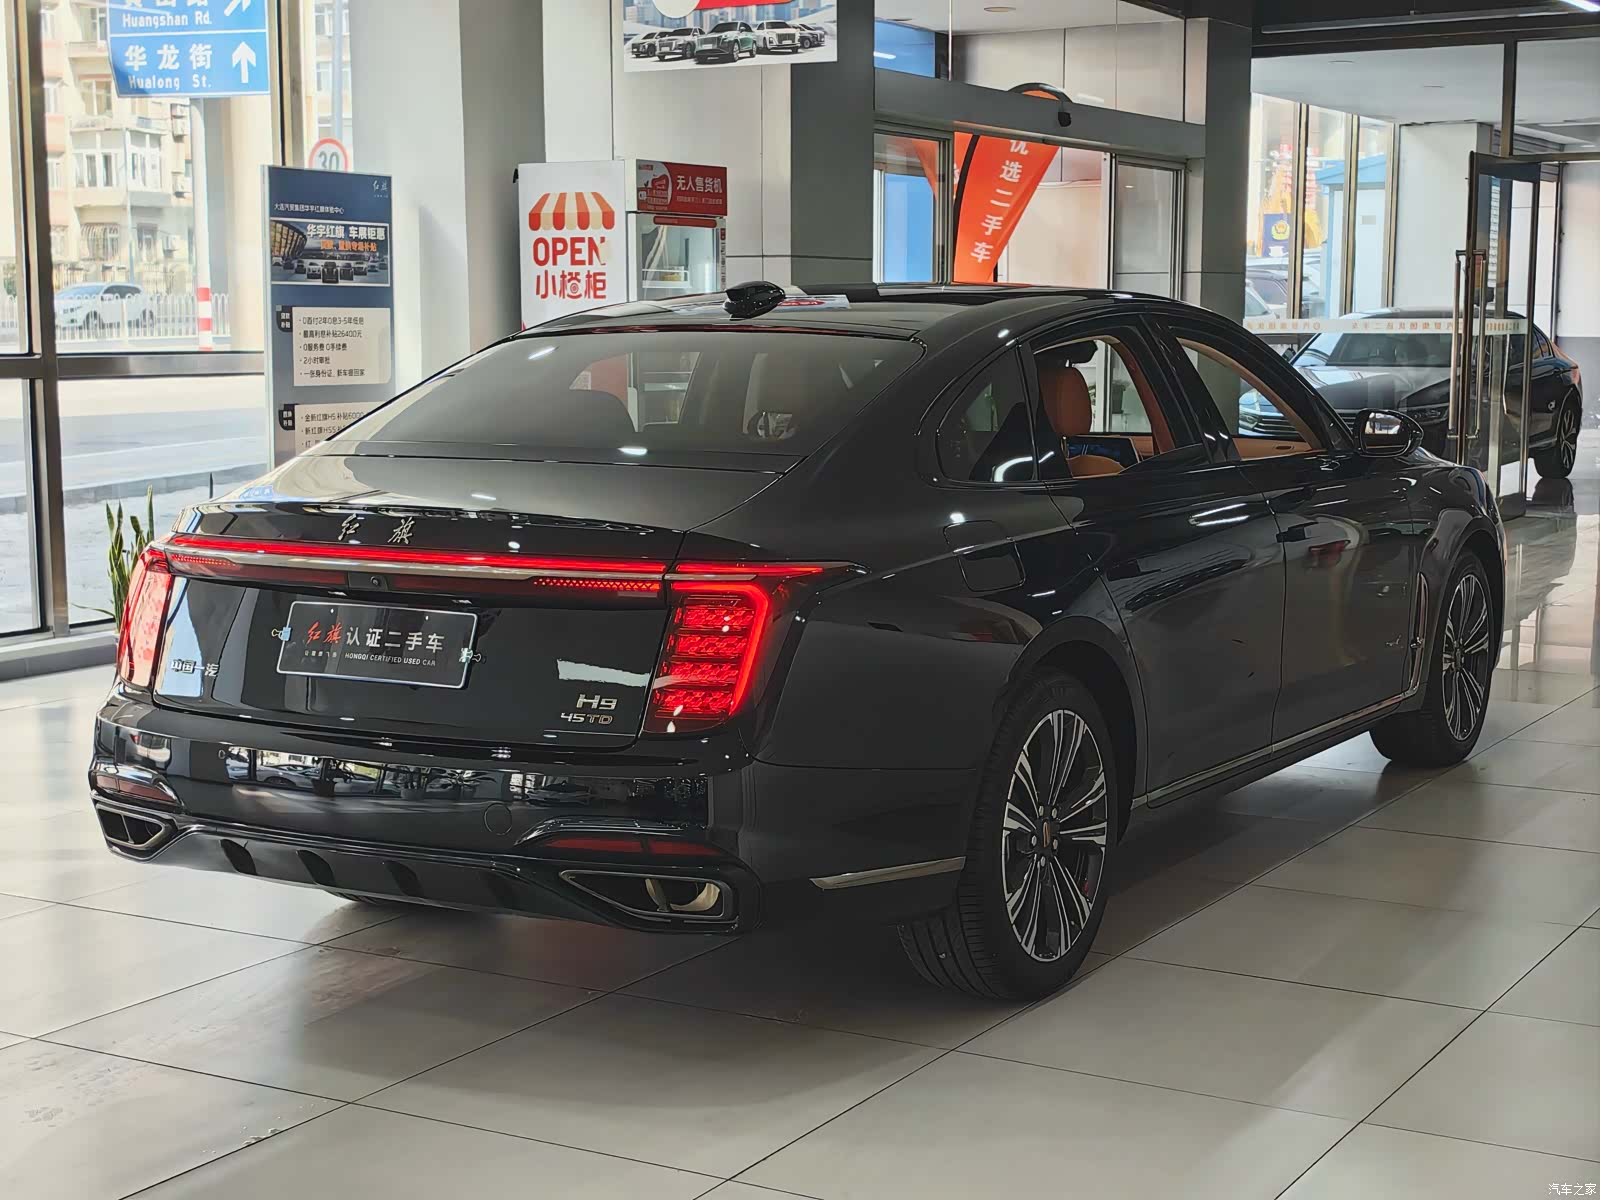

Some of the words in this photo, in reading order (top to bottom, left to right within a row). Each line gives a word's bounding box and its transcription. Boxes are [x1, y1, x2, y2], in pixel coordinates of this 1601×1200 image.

[122, 13, 188, 29] Huangshan
[194, 11, 212, 25] Rd.
[124, 43, 213, 71] 华龙街
[128, 74, 180, 90] Hualong
[192, 74, 212, 88] St.
[318, 151, 340, 171] 30
[676, 175, 723, 194] 无人售货机
[307, 224, 344, 239] 华宇红旗
[532, 236, 606, 267] OPEN
[337, 512, 416, 545] 红旗
[171, 658, 220, 677] 中国一汽
[344, 652, 369, 661] HONGQI
[370, 654, 402, 664] CERTIFIED
[403, 657, 421, 666] USED
[422, 659, 437, 667] CAR
[576, 693, 618, 710] H9
[560, 712, 614, 726] 45TD
